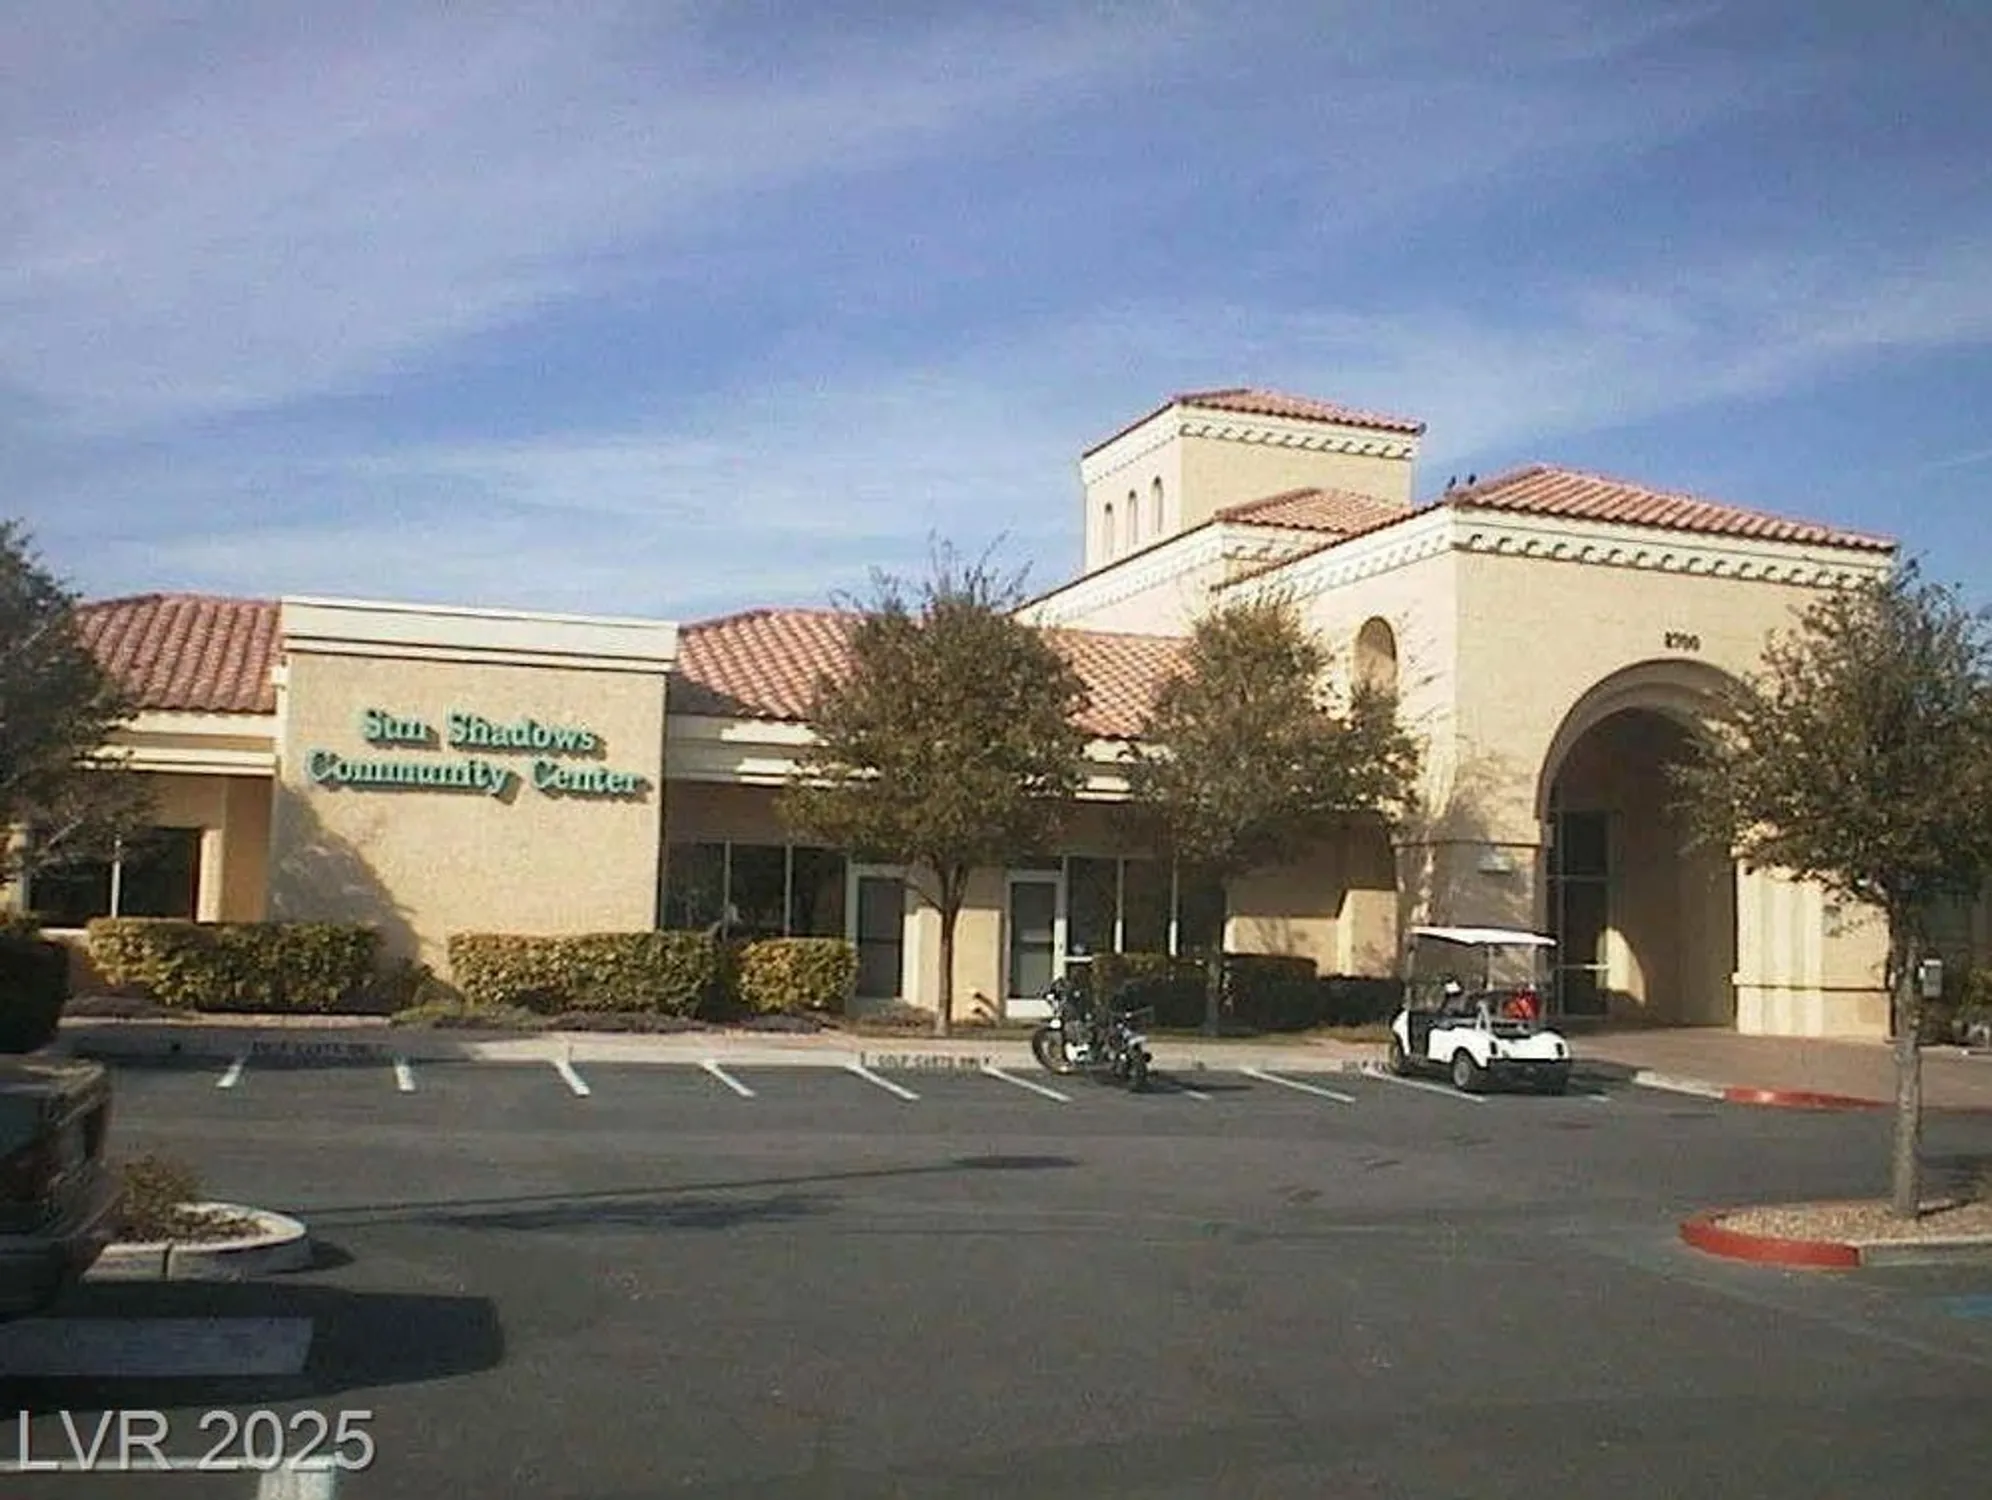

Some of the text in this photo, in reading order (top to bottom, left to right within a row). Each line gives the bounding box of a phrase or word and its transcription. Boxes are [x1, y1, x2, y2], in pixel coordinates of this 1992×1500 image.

[361, 707, 600, 752] Sun Shadows
[307, 750, 643, 794] Community Center
